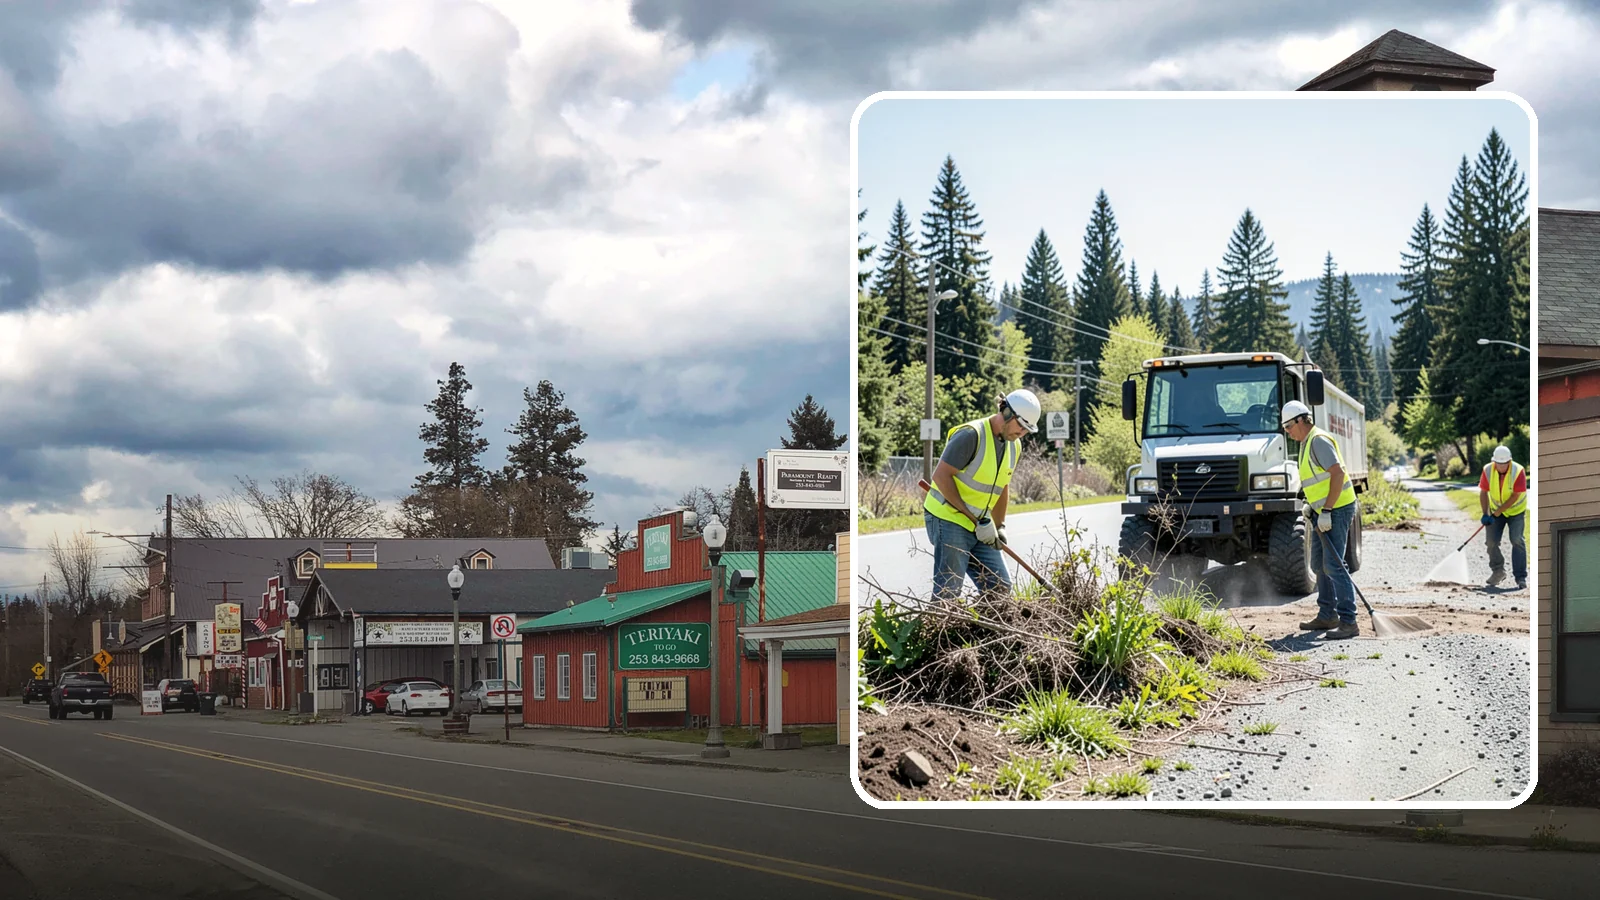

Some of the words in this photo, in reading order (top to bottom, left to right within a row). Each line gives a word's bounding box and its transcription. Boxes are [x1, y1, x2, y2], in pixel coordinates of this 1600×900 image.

[625, 627, 702, 646] TERIYAKI
[628, 654, 648, 665] 253
[651, 653, 700, 664] 843-9668
[639, 681, 672, 691] TERIYAKI
